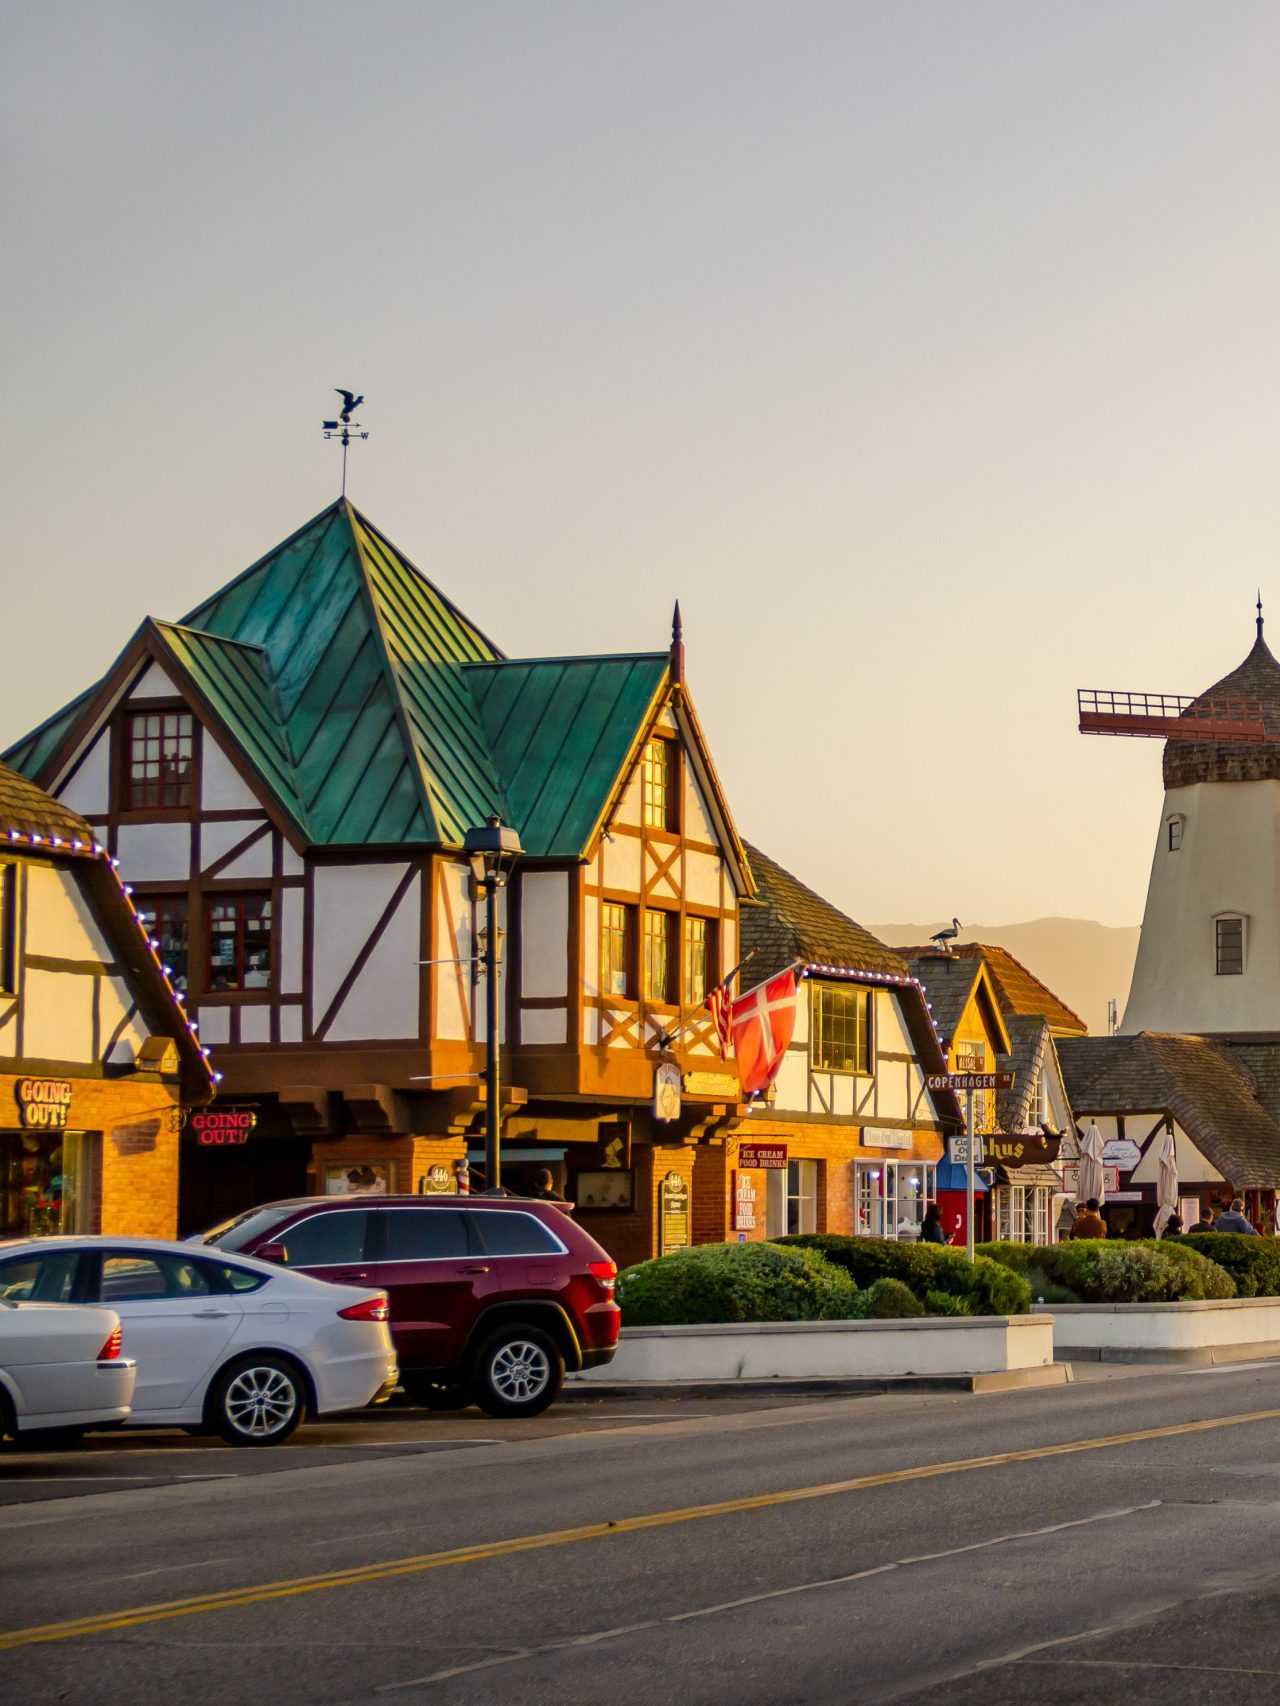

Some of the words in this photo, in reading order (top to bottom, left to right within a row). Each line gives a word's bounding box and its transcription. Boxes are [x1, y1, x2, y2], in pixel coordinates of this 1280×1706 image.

[928, 1076, 996, 1089] COPENHAGEN
[20, 1079, 71, 1104] GOING
[26, 1103, 67, 1127] OUT!
[192, 1113, 251, 1128] GOING
[200, 1129, 245, 1144] OUT!
[742, 1150, 755, 1158] ICE
[757, 1150, 784, 1159] CREAM
[739, 1159, 758, 1167] FOOD
[759, 1159, 787, 1168] DRINKS
[433, 1168, 449, 1182] 446
[736, 1188, 756, 1202] CREAM
[739, 1202, 753, 1216] FOOD
[736, 1215, 756, 1230] DRINKS
